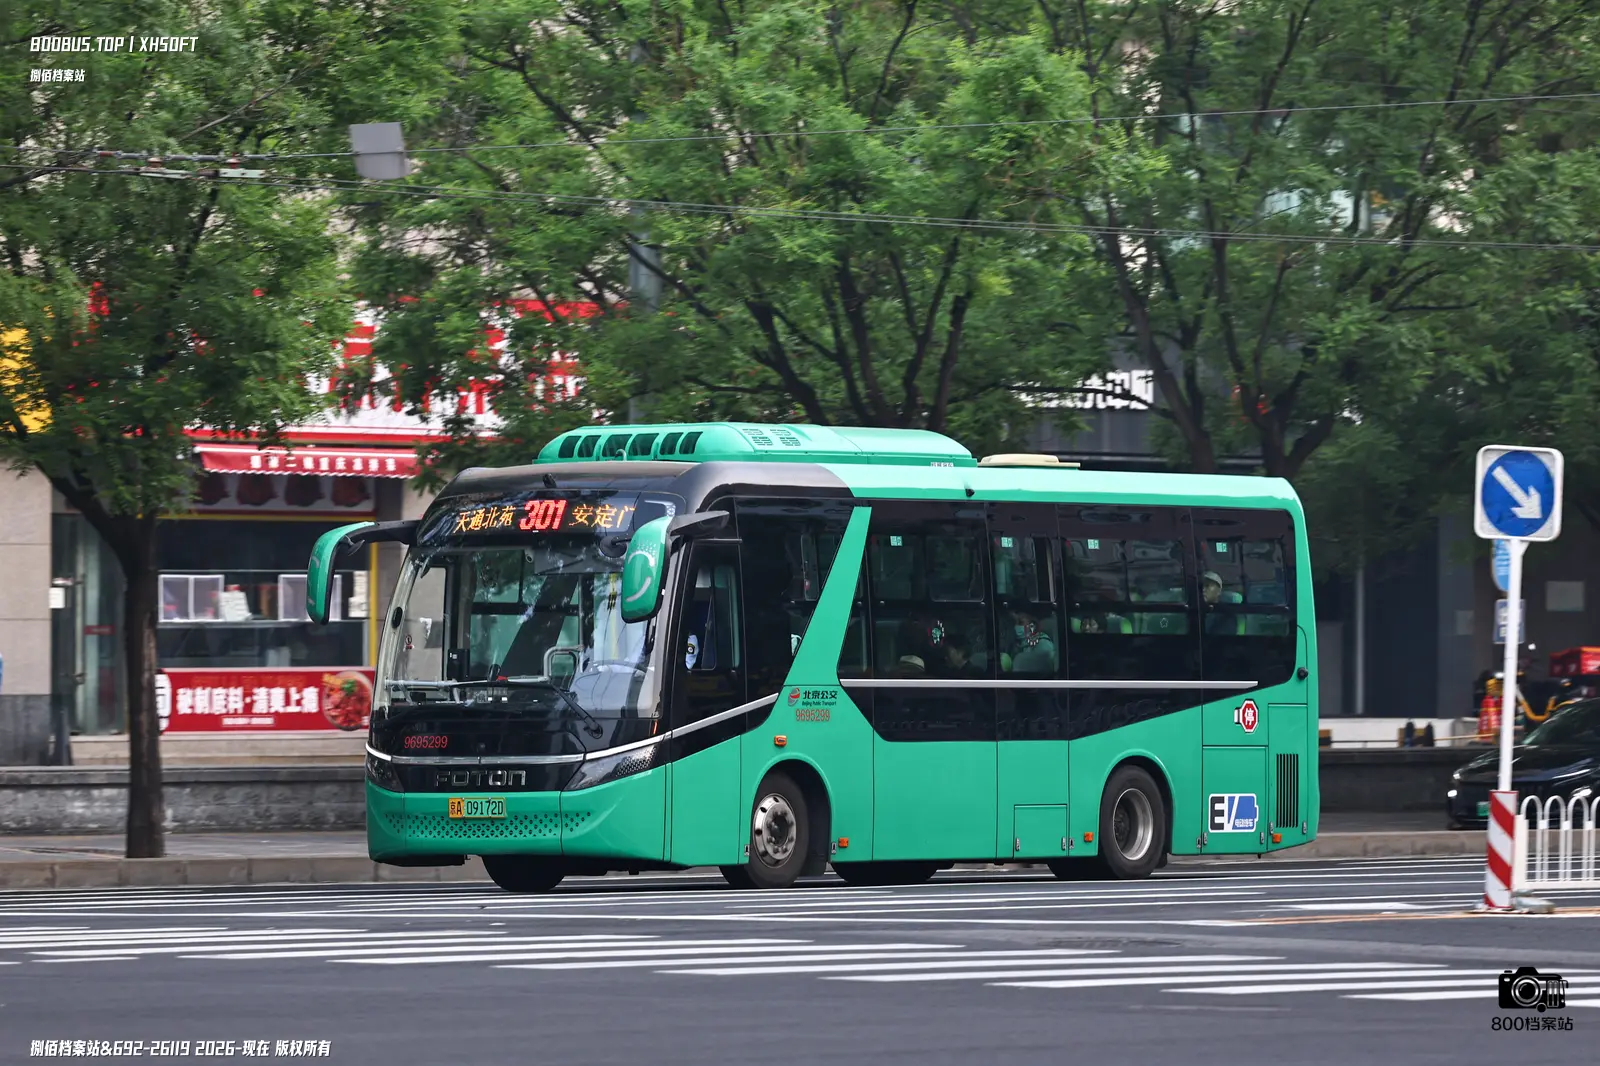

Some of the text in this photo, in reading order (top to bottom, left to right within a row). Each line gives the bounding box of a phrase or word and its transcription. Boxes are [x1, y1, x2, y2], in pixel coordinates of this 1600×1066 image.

[453, 505, 516, 534] 天通北苑
[519, 499, 568, 530] 301
[803, 690, 838, 700] 北京公交
[796, 709, 830, 722] 9695299
[1244, 707, 1255, 726] 停
[404, 735, 448, 749] 9695299
[436, 770, 527, 787] FOTON
